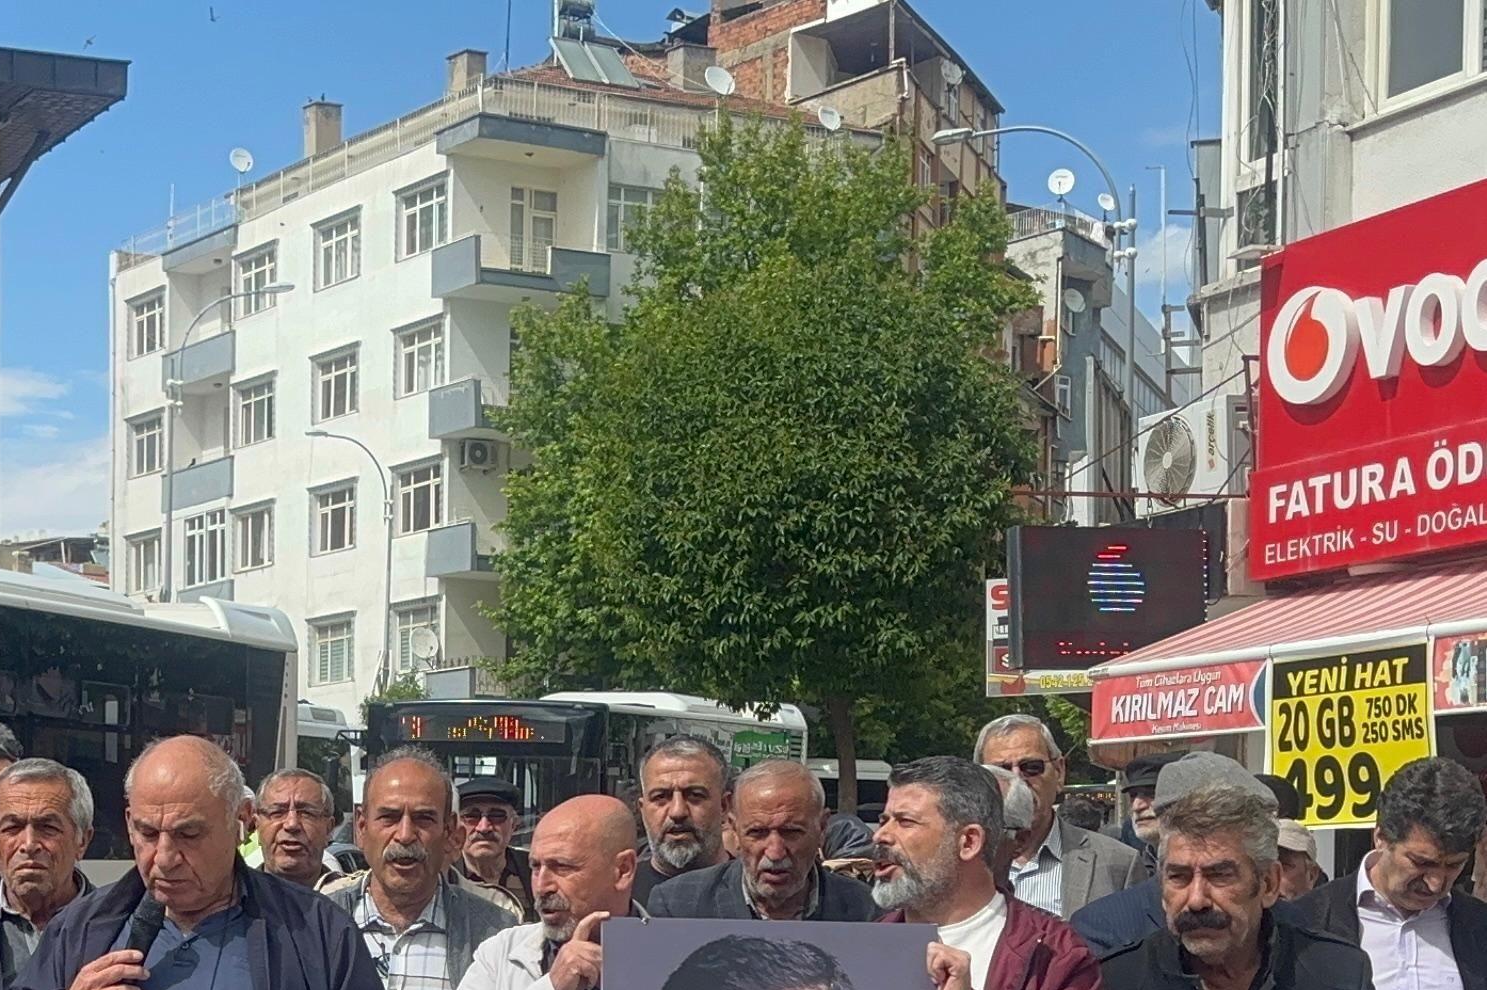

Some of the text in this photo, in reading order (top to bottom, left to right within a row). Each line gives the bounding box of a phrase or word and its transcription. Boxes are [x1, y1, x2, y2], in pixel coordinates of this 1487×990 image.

[1268, 457, 1416, 524] FATURA
[1265, 525, 1354, 565] ELEKTRİK
[1372, 520, 1399, 545] SU
[1287, 656, 1409, 696] YENİ HAT
[1111, 683, 1245, 724] KIRILMAZ CAM
[1278, 695, 1356, 752] 20 GB
[1366, 692, 1417, 719] 750 DK
[1362, 716, 1425, 744] 250 SMS
[1286, 751, 1381, 821] 499
